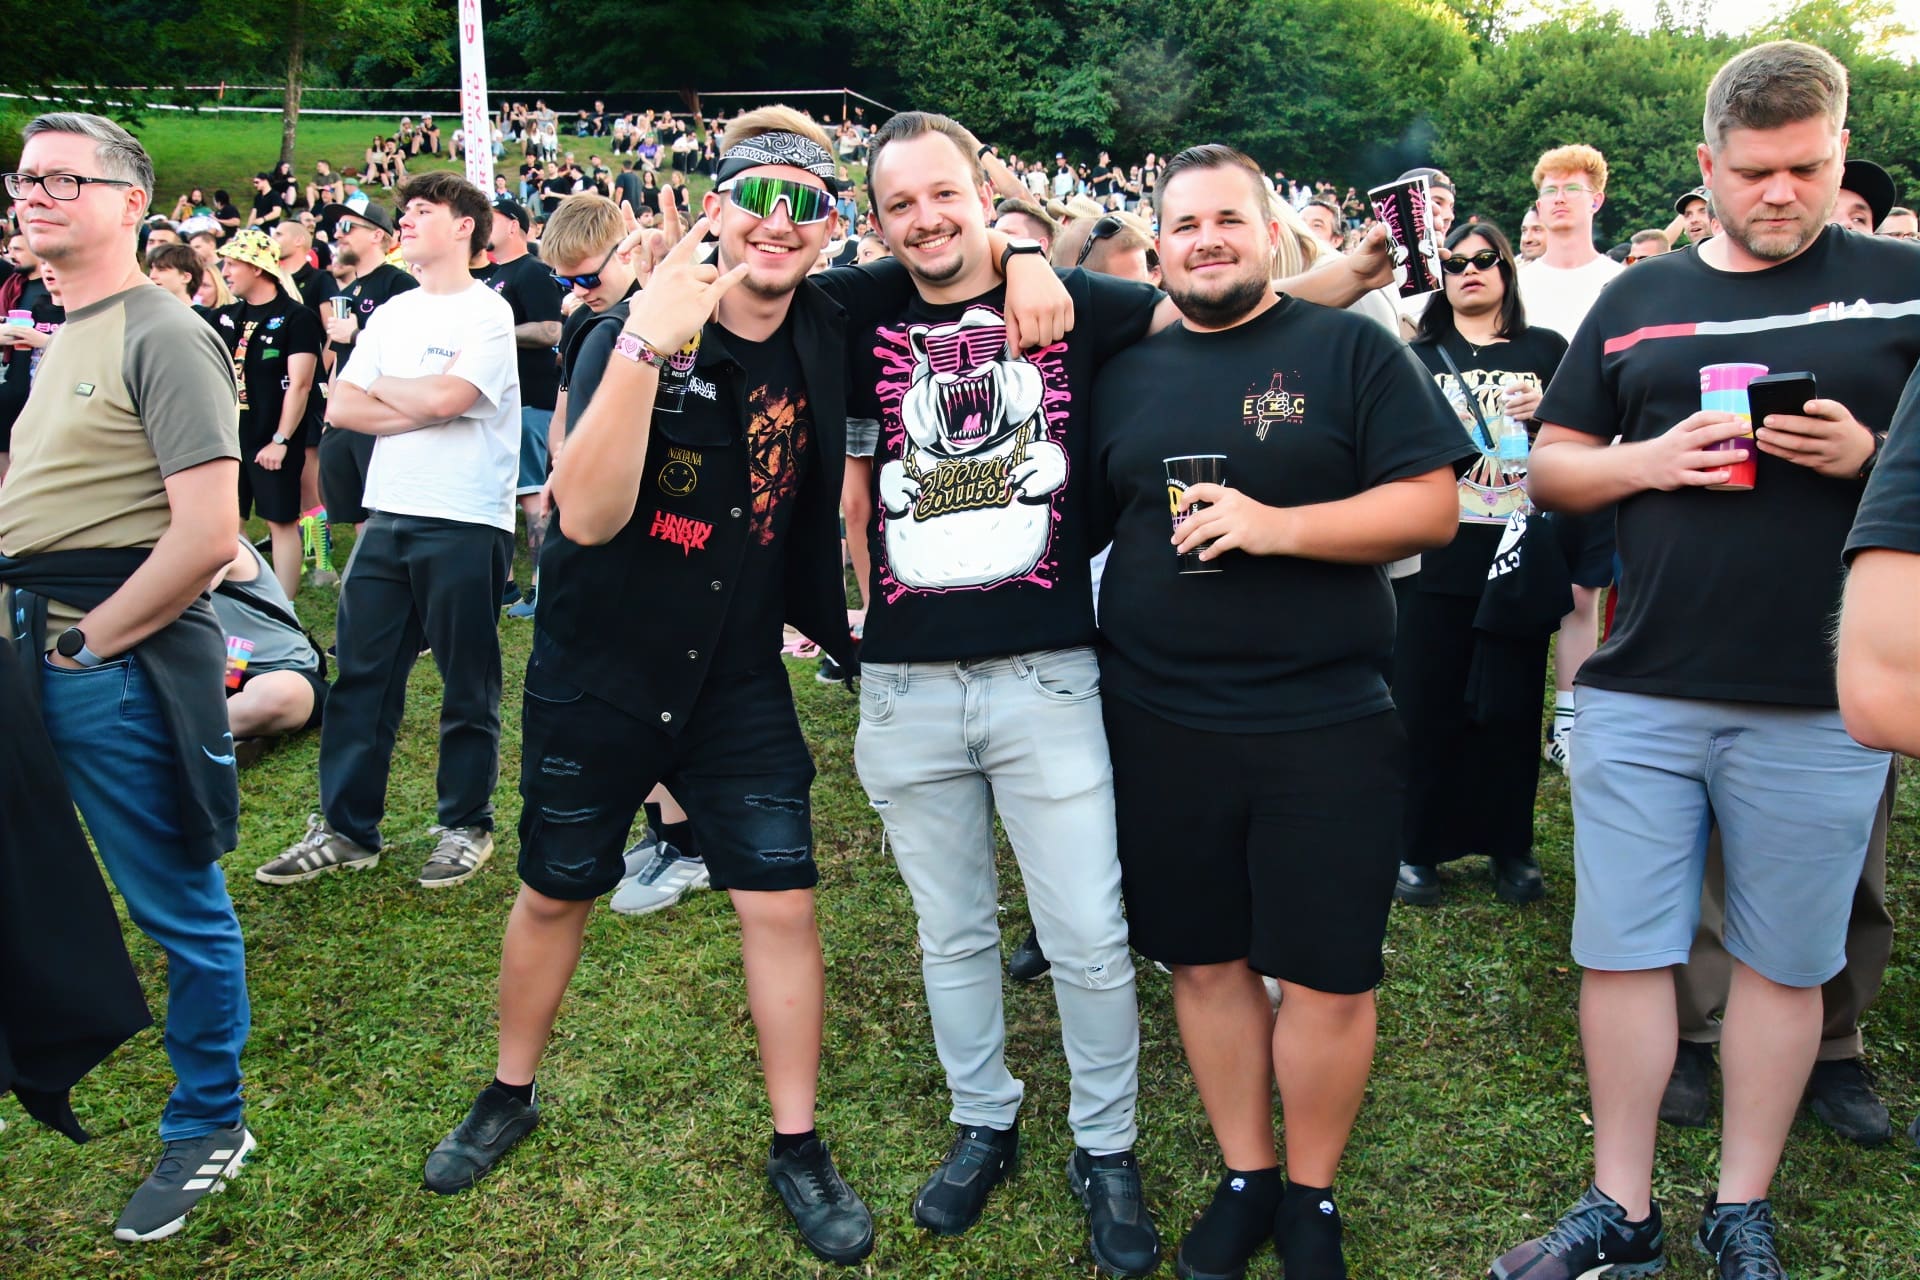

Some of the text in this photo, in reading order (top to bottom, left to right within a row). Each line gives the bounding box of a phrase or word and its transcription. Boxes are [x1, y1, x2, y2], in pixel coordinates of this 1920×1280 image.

[1808, 298, 1873, 324] FILA
[667, 447, 702, 467] NIRVANA
[649, 521, 706, 558] PARK
[654, 510, 714, 541] LINKIN
